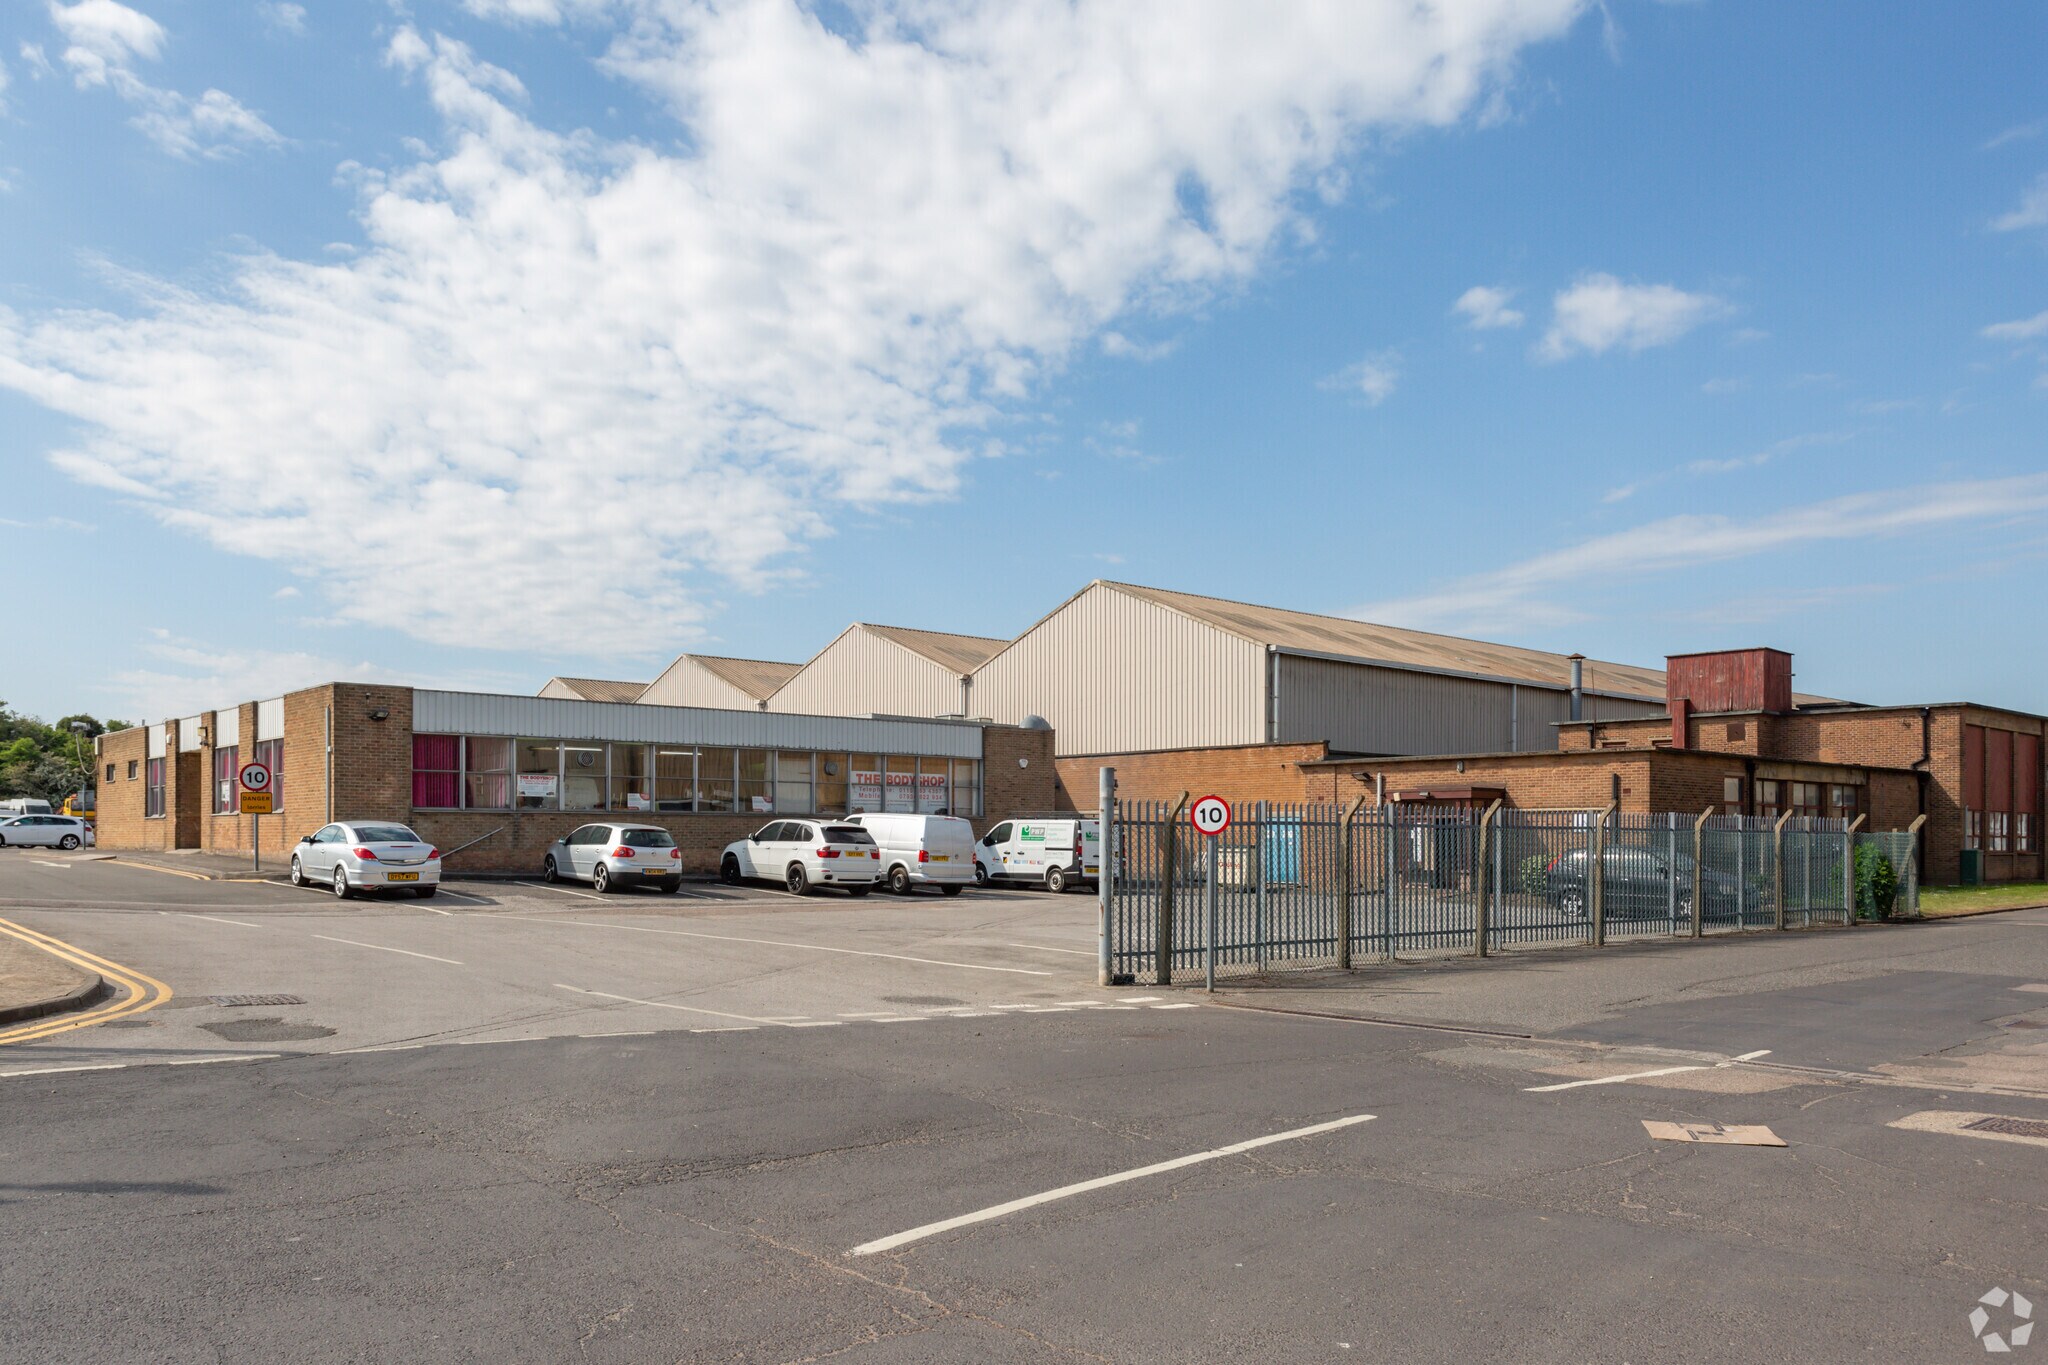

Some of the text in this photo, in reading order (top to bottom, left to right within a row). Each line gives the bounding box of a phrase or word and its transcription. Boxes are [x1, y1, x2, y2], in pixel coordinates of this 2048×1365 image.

[247, 772, 264, 783] 10
[856, 774, 880, 784] THE
[1200, 807, 1222, 823] 10
